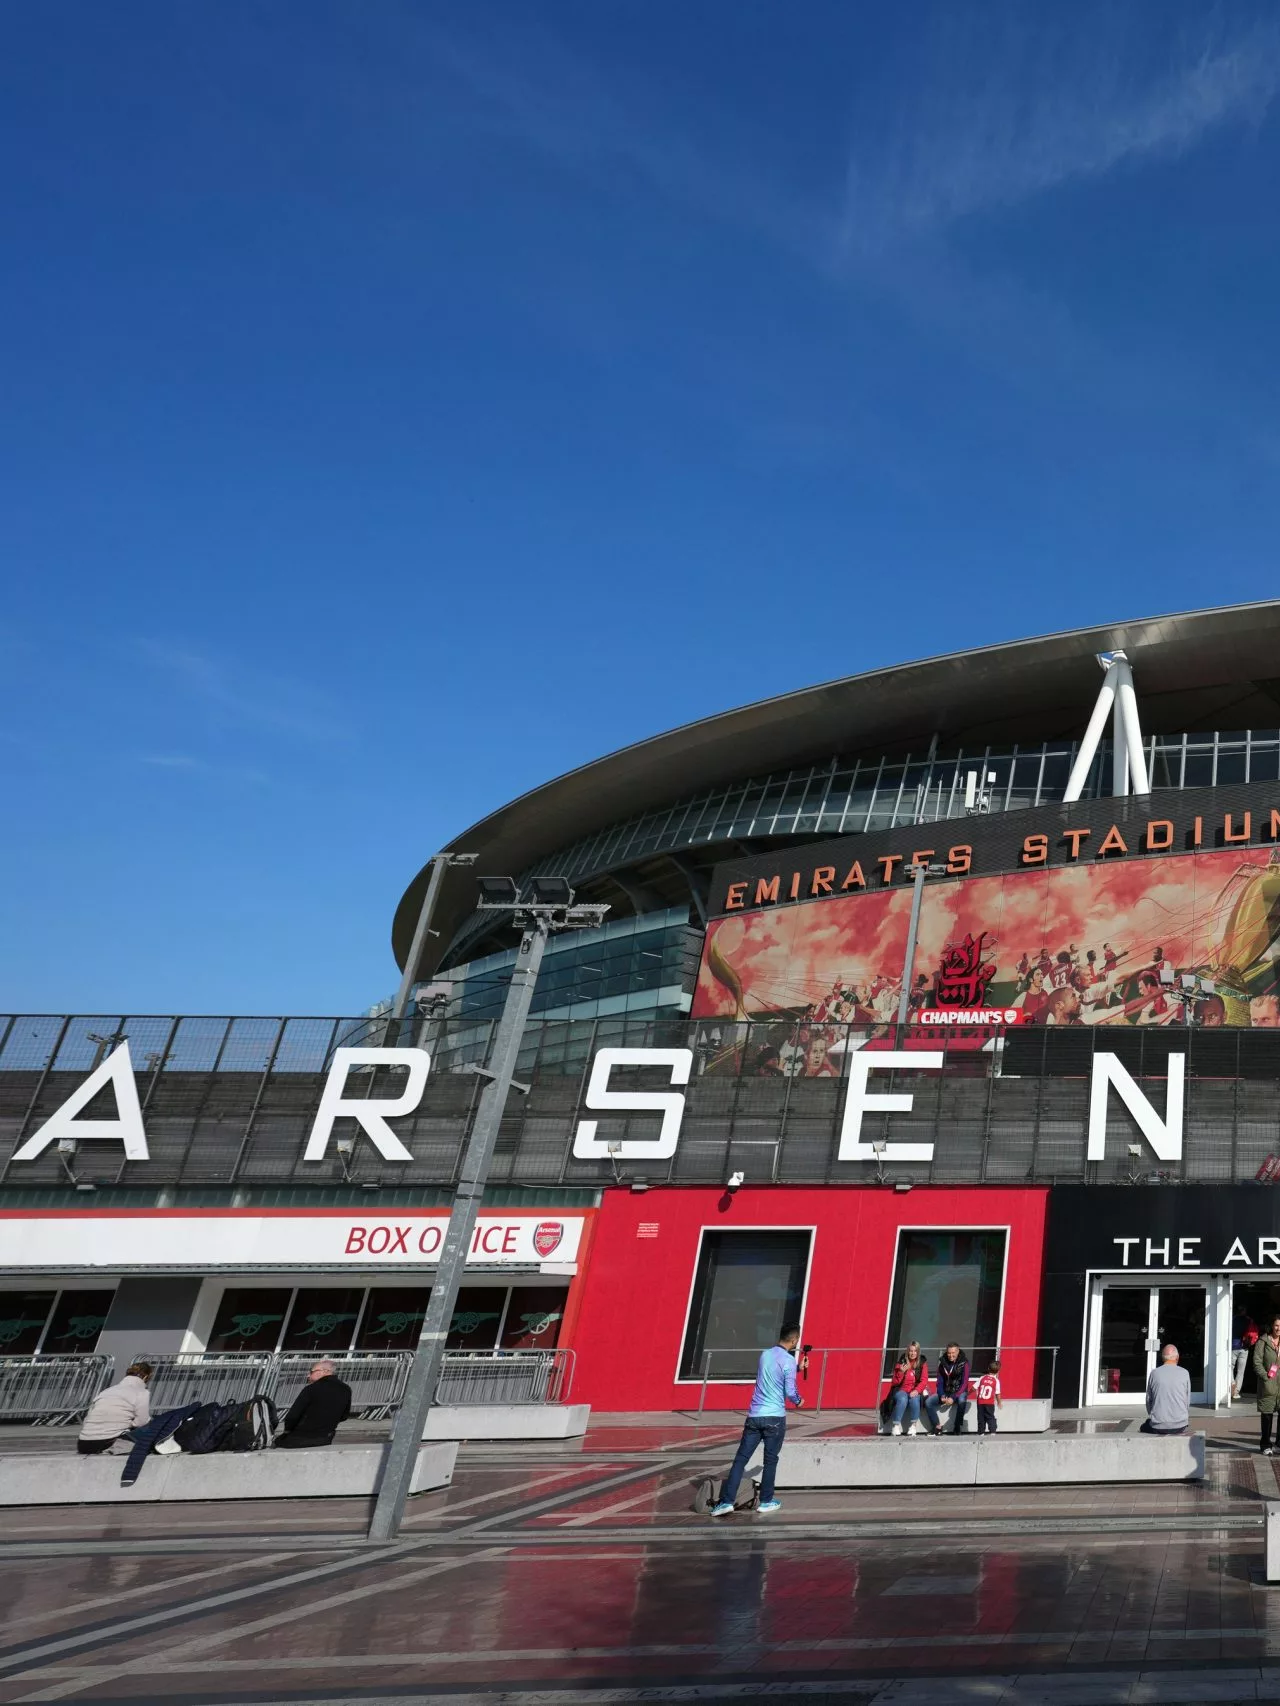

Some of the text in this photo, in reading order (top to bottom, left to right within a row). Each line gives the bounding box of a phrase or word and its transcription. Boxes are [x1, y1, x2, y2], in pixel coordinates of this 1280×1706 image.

[725, 844, 973, 910] EMIRATES
[921, 1011, 1003, 1024] CHAPMAN'S
[344, 1226, 521, 1254] BOX OICE
[1113, 1237, 1201, 1266] THE
[979, 1384, 993, 1400] 10
